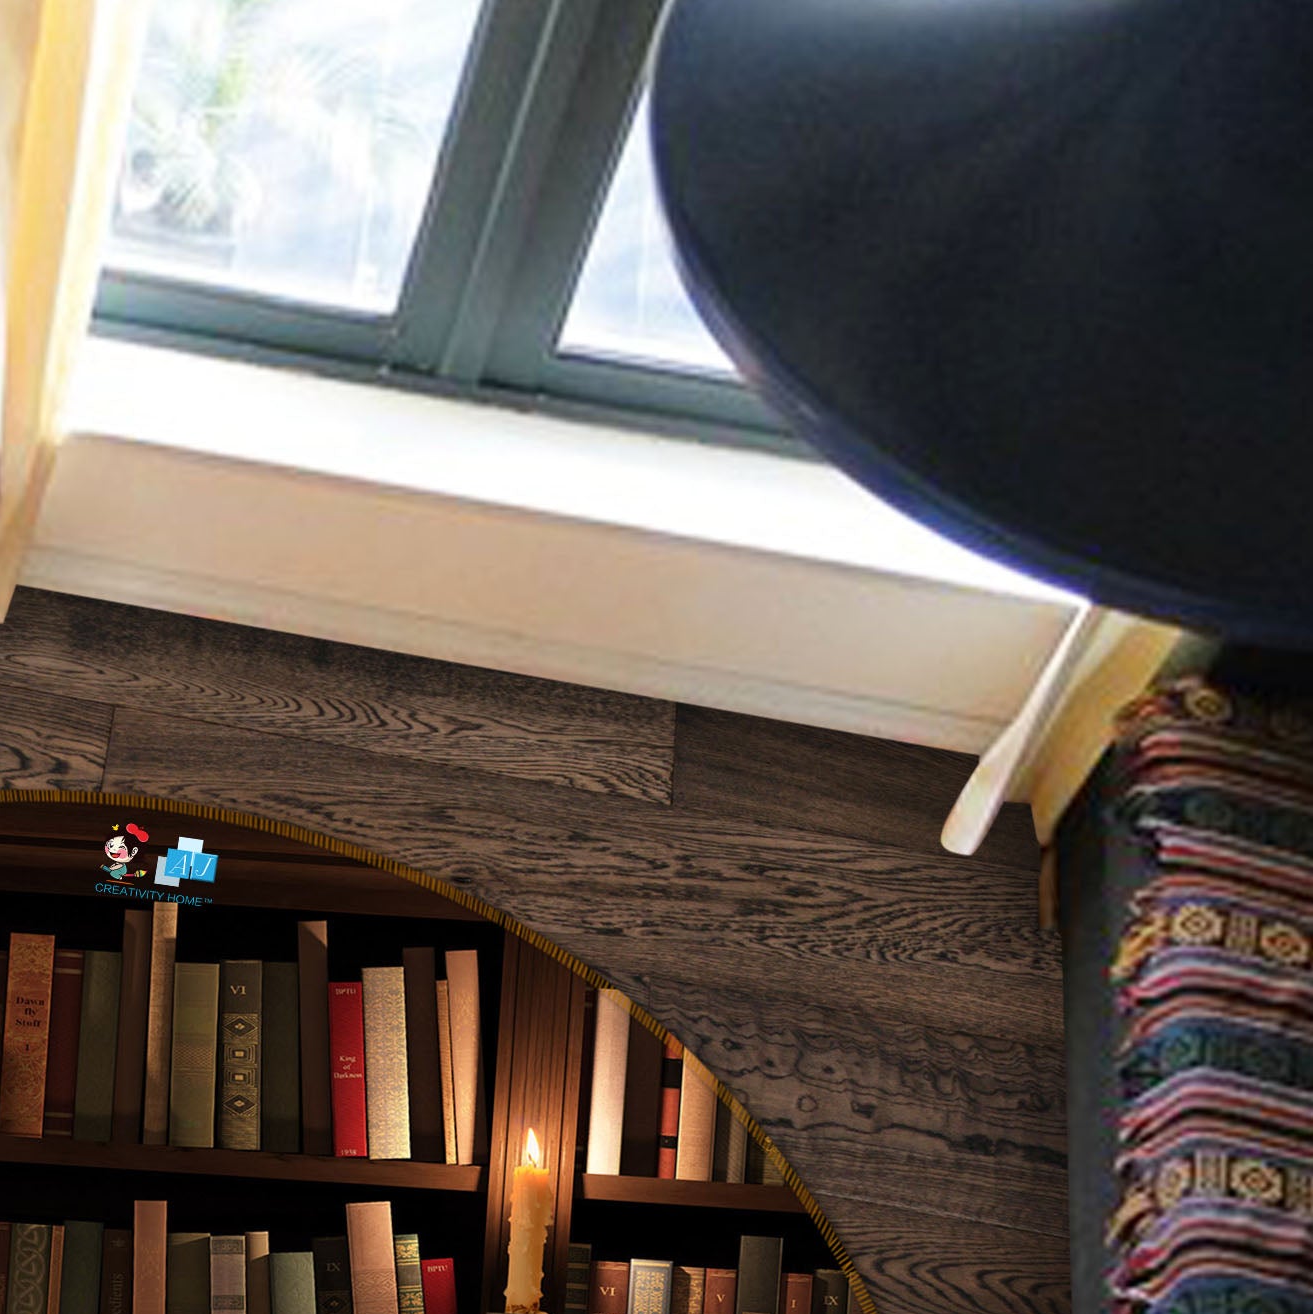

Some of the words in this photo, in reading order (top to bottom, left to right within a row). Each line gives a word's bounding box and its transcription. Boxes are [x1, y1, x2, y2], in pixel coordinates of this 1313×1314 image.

[230, 985, 246, 995] VI
[16, 996, 45, 1007] Dawn
[339, 1055, 356, 1064] King
[326, 1262, 341, 1272] IX
[600, 1287, 616, 1296] VI
[717, 1294, 725, 1302] V
[823, 1295, 838, 1306] IX
